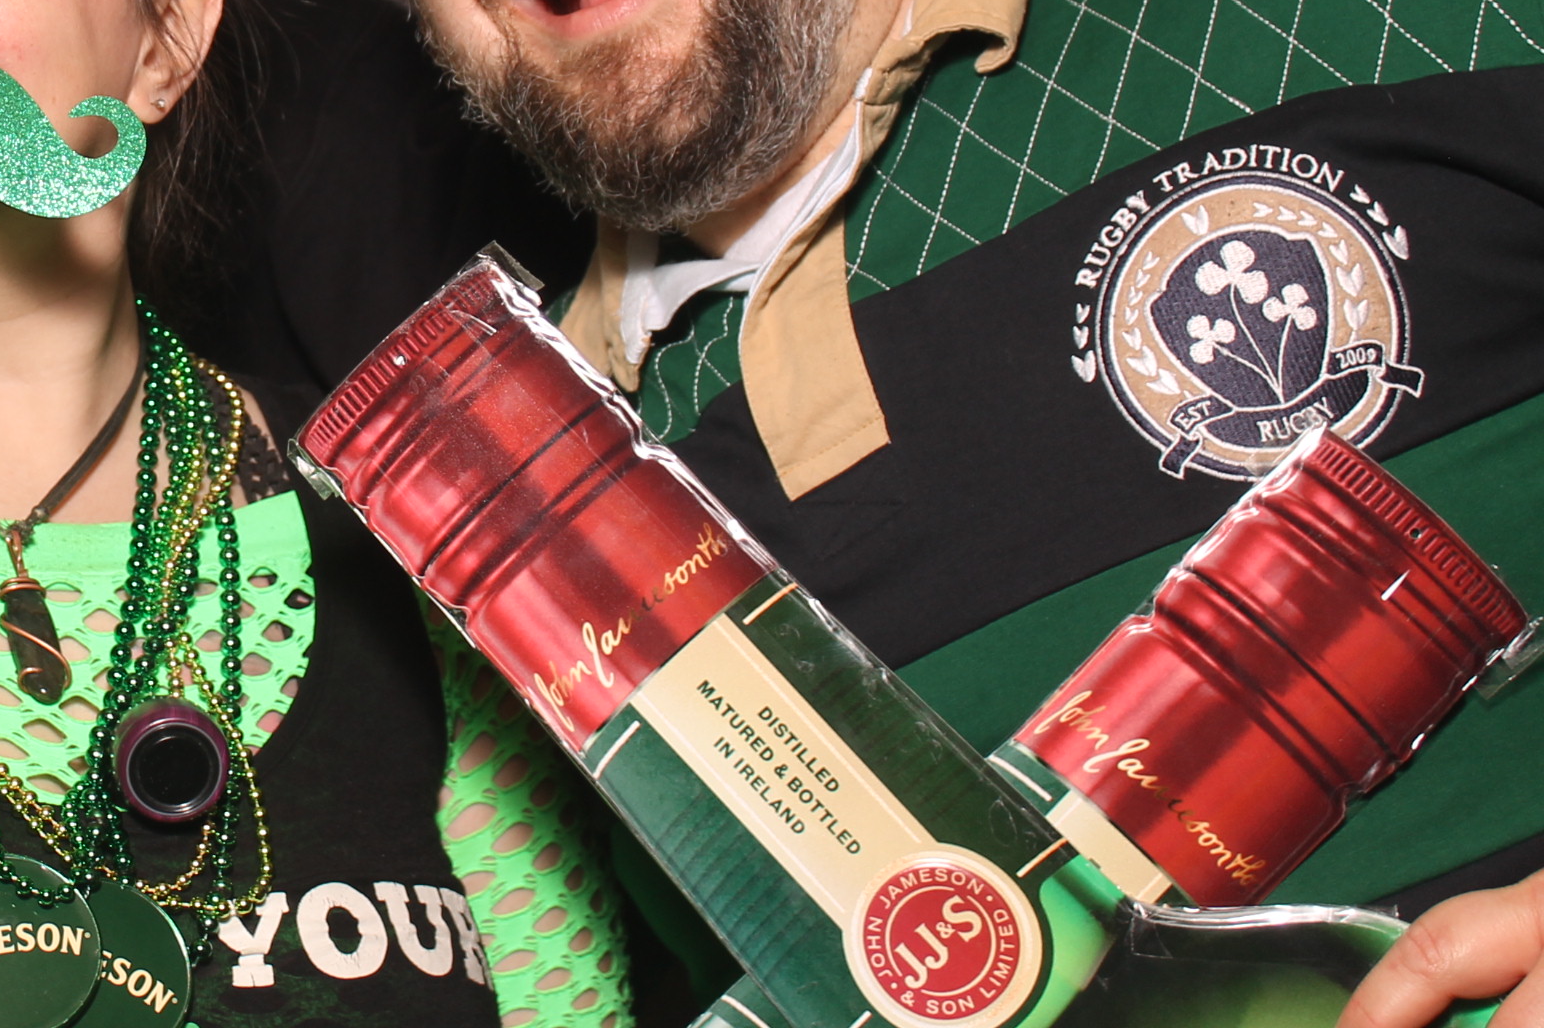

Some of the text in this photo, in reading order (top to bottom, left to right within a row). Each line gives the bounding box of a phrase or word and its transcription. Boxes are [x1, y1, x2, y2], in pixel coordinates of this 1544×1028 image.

[1074, 143, 1345, 289] RUGBY TRADITION
[1174, 347, 1377, 431] EST 2009
[1255, 396, 1337, 444] RUGBY
[696, 680, 862, 856] MATURED & BOTTLED
[713, 736, 807, 836] IN IRELAND
[756, 706, 840, 793] DISTILLED
[866, 867, 985, 978] JOHN JAMESON
[900, 908, 1015, 1015] & SON LIMITED
